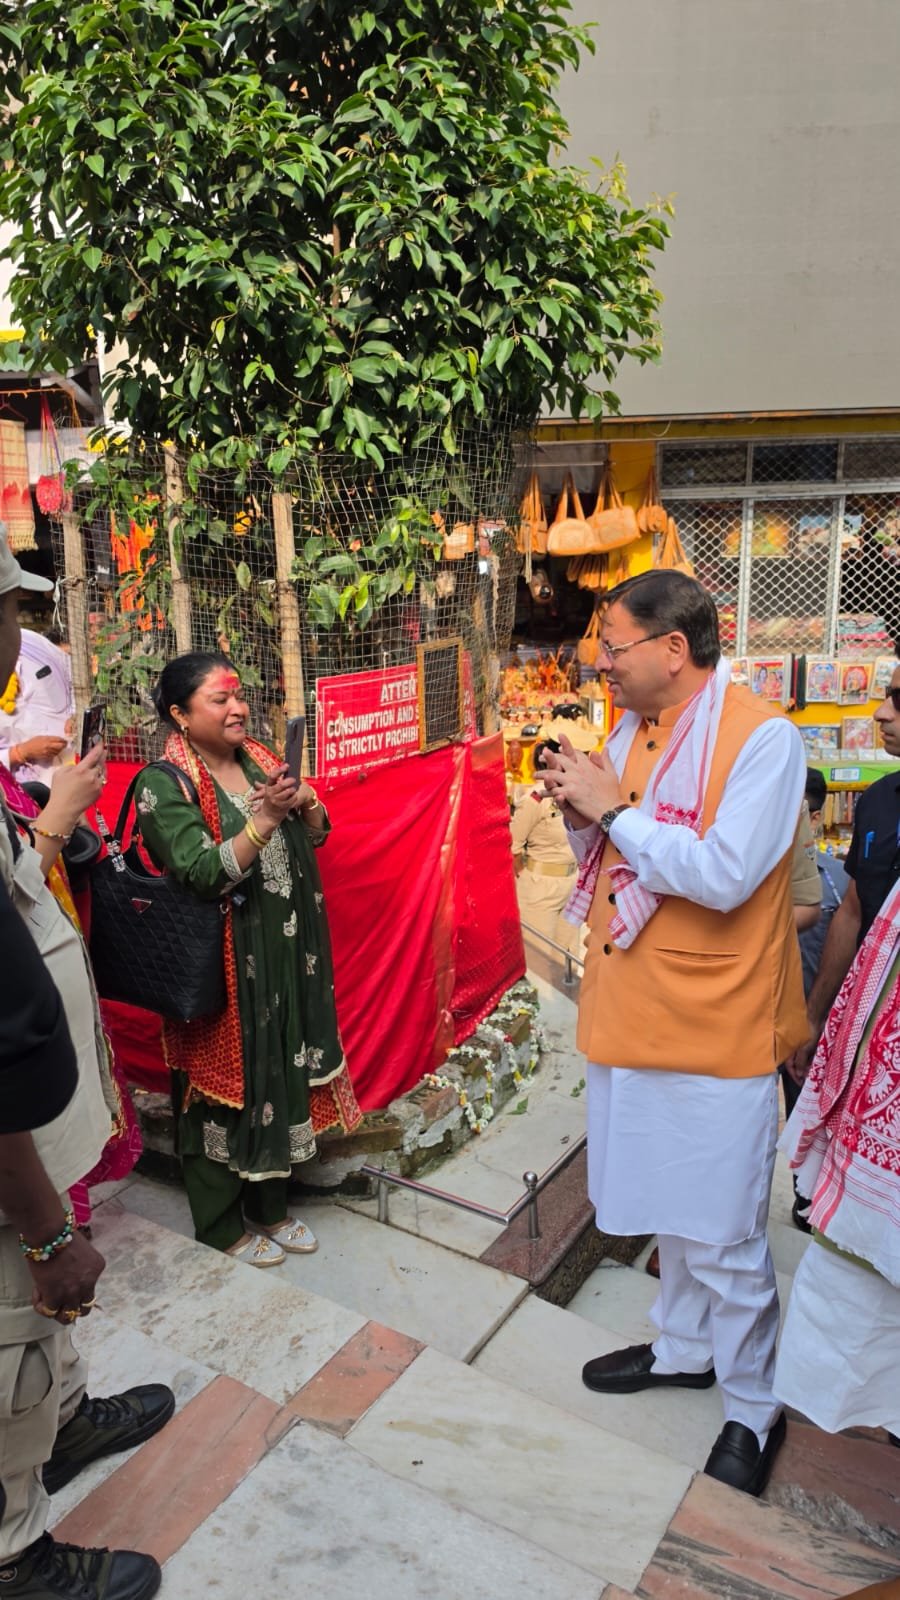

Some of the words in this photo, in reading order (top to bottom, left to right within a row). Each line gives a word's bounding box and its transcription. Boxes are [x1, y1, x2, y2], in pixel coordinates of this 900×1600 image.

[381, 678, 416, 702] ATTEN
[327, 709, 395, 738] CONSUMPTION
[397, 705, 414, 725] AND
[326, 742, 336, 761] IS
[338, 734, 384, 759] STRICTLY
